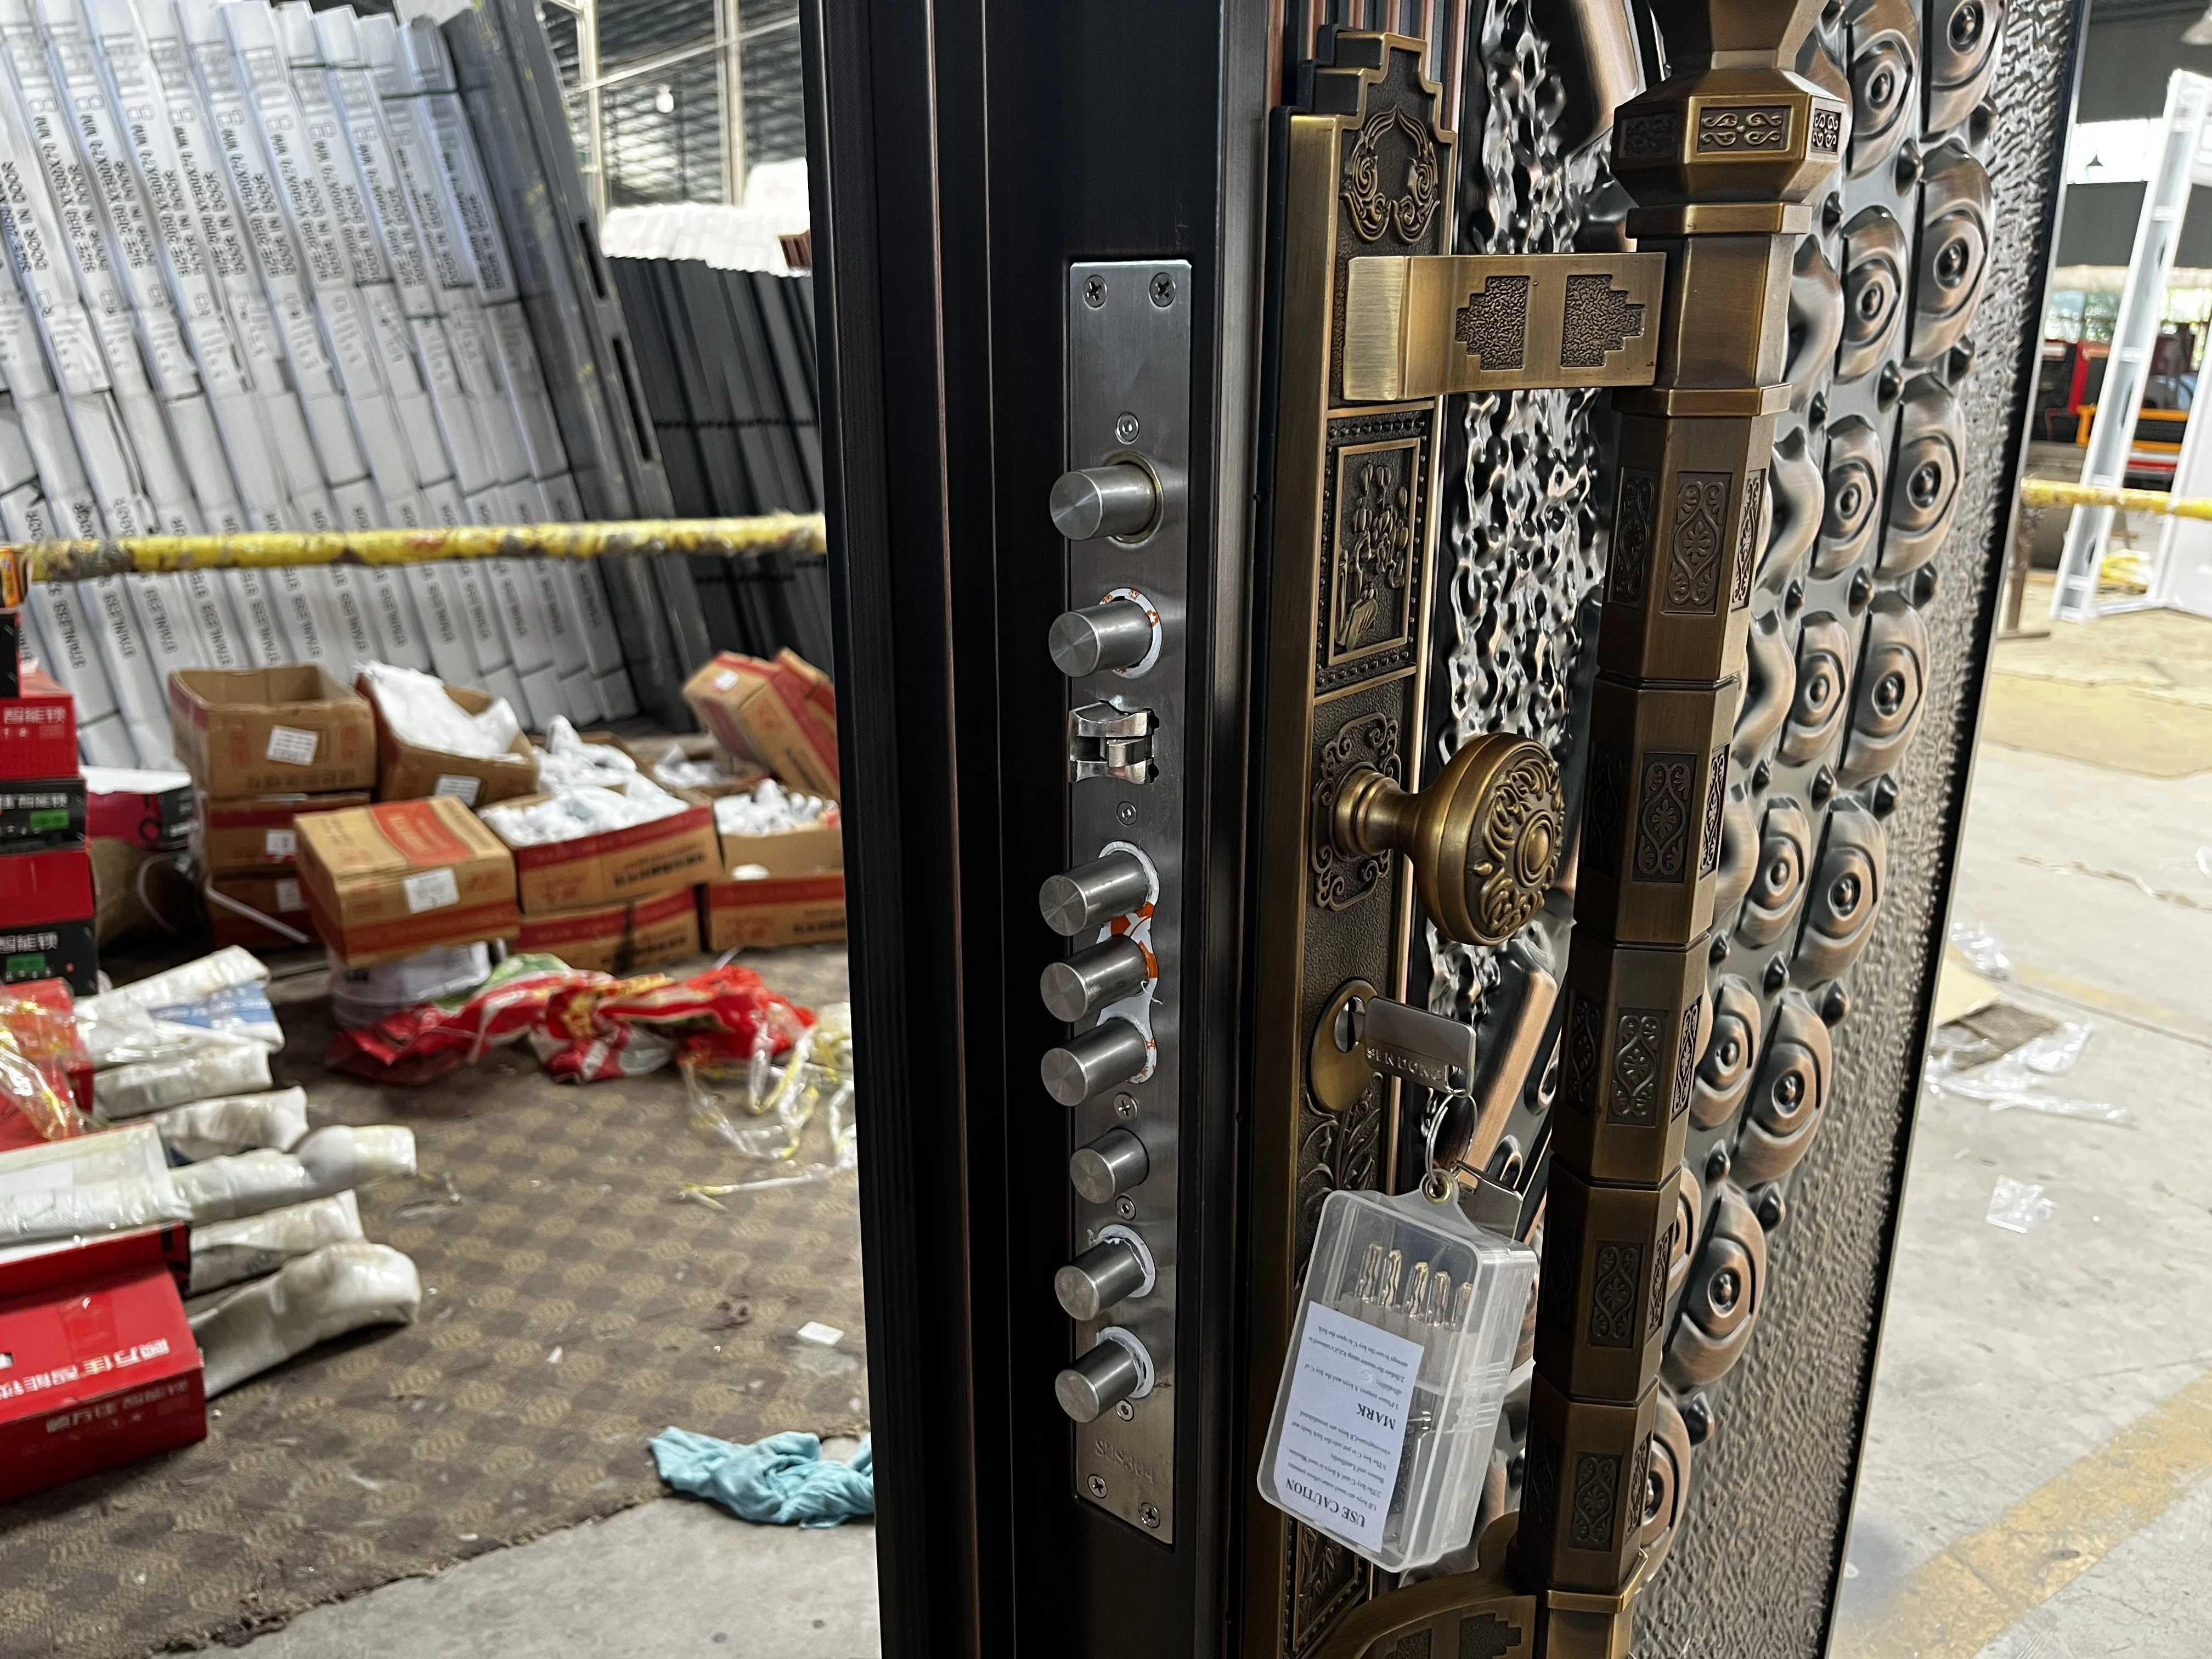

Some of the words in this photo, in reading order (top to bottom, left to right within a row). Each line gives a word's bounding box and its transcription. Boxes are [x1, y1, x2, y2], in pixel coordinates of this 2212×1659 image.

[0, 162, 27, 202] DOOR
[66, 165, 92, 203] DOOR
[16, 209, 32, 222] IN
[176, 216, 191, 229] IN
[217, 216, 234, 230] IN
[267, 217, 282, 231] IN
[316, 222, 331, 235] IN
[23, 230, 49, 269] DOOR
[4, 706, 66, 725] 智能锁
[1356, 1402, 1396, 1431] MARK
[1094, 1438, 1155, 1485] SUS304
[1285, 1476, 1339, 1514] CAUTION
[1341, 1505, 1365, 1528] USE
